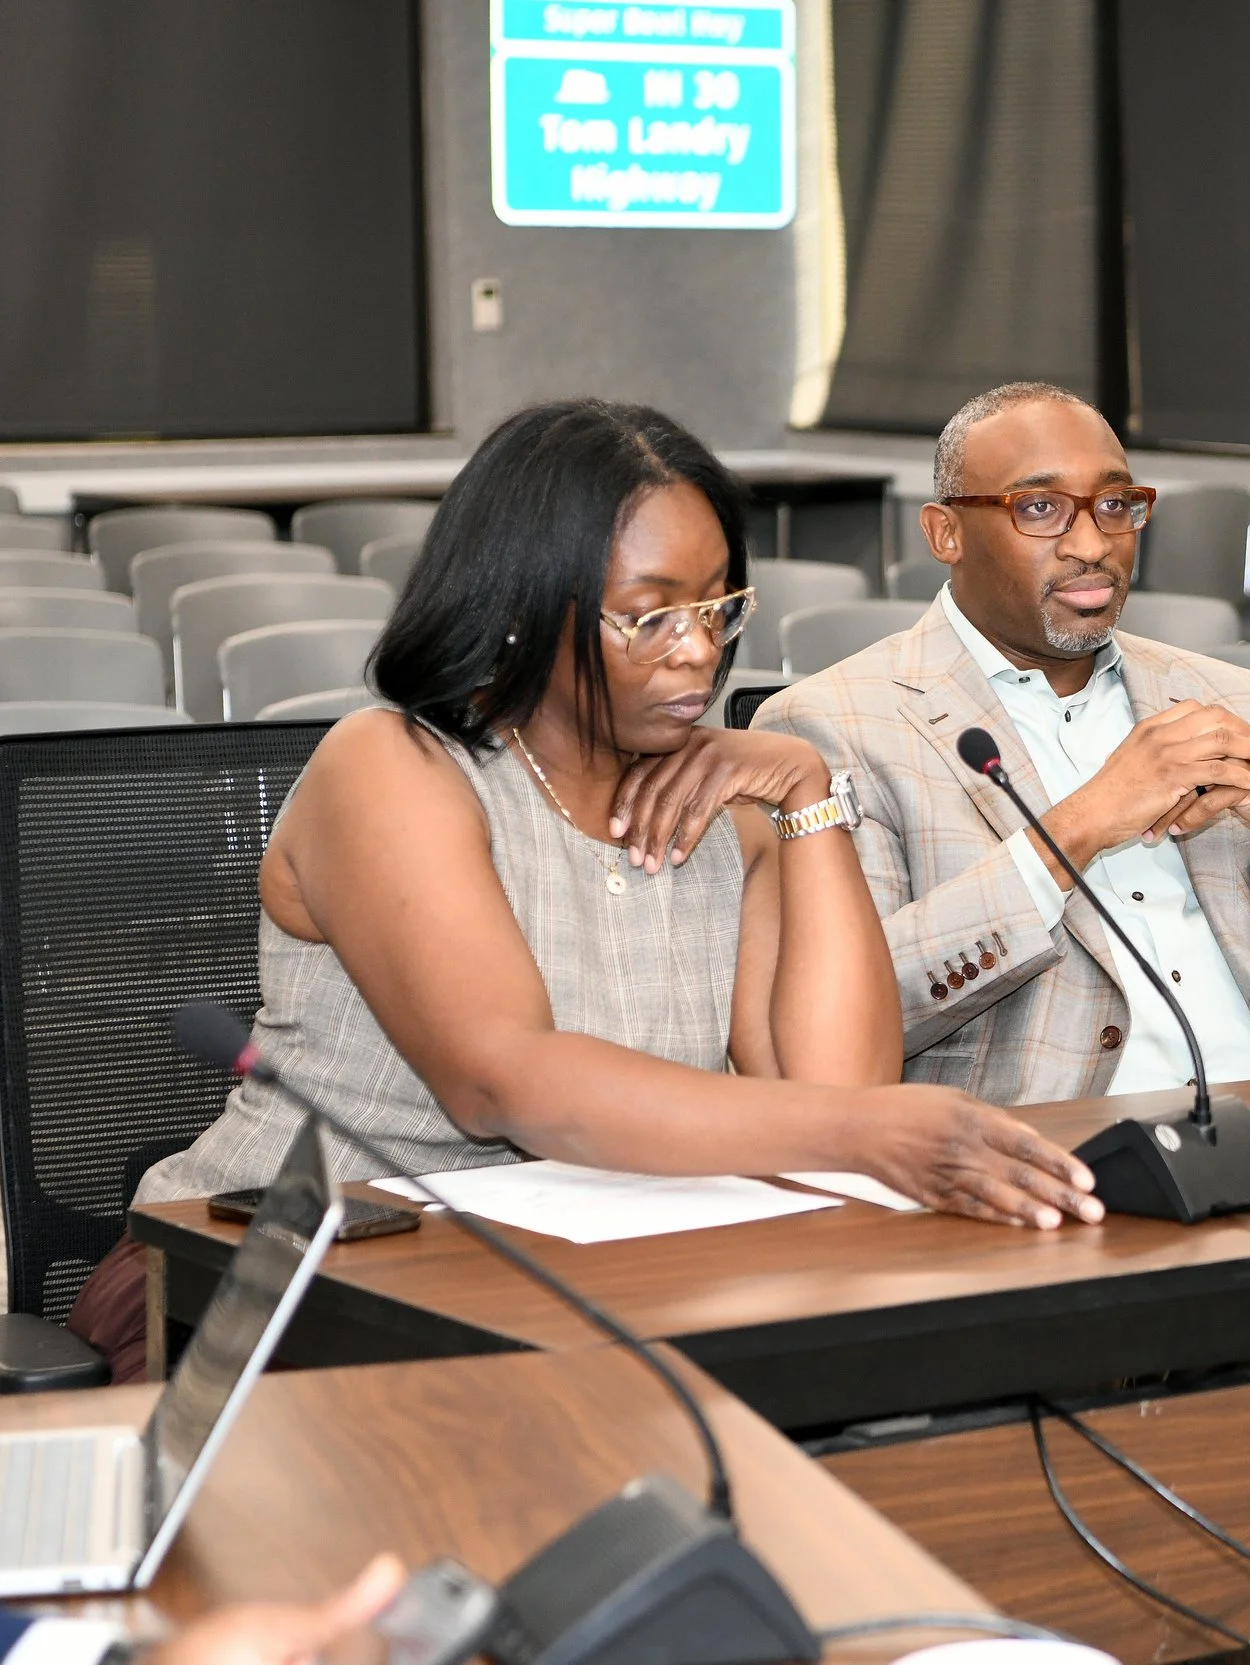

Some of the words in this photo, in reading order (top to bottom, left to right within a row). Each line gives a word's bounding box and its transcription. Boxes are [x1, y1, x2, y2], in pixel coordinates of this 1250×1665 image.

[543, 5, 619, 38] Super
[692, 70, 740, 110] 30
[538, 113, 618, 154] Tom
[627, 115, 751, 165] Landry
[569, 162, 722, 211] Highway
